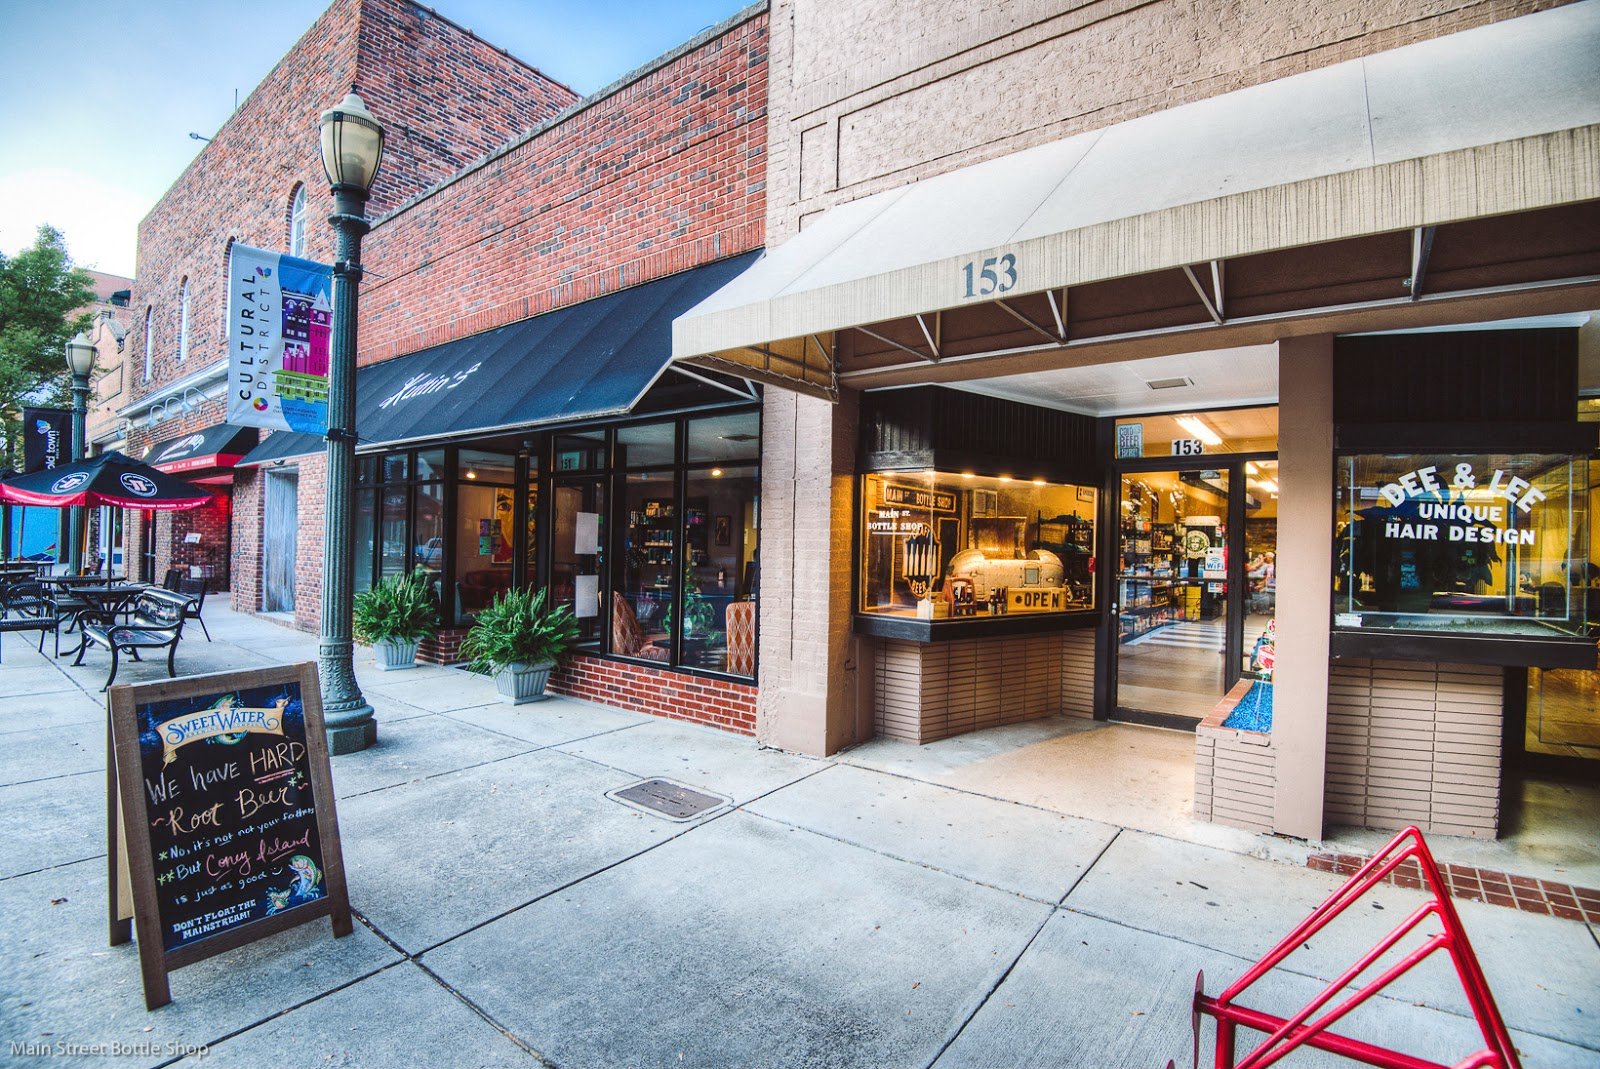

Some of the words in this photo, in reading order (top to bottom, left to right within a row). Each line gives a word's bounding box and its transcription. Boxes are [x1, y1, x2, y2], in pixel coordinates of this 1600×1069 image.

[962, 253, 1017, 298] 153
[239, 275, 256, 400] CULTURAL
[257, 288, 270, 390] DISTRICT
[46, 430, 56, 453] town
[1120, 435, 1139, 448] BEER
[1174, 440, 1202, 455] 153
[886, 488, 903, 502] MAIN
[916, 493, 936, 506] BOTTLE
[937, 496, 952, 508] SHOP
[1379, 465, 1441, 508] DEE
[1453, 462, 1476, 489] &
[1488, 469, 1547, 513] LEE
[879, 510, 899, 518] MAIN
[1419, 502, 1503, 523] UNIQUE
[867, 522, 897, 530] BOTTLE
[900, 522, 923, 530] SHOP
[1385, 523, 1438, 541] HAIR
[1449, 526, 1535, 546] DESIGN
[912, 579, 926, 594] BEER
[1024, 592, 1059, 608] OPEN
[250, 741, 306, 776] HARD
[166, 802, 224, 836] Root
[235, 785, 294, 819] Beer
[192, 836, 210, 850] it's
[214, 832, 234, 846] not
[238, 825, 254, 837] not
[256, 817, 279, 834] your
[176, 860, 202, 880] But
[206, 850, 250, 877] Coney
[256, 828, 310, 863] Island
[175, 894, 188, 905] is
[196, 886, 217, 902] just
[220, 882, 232, 892] as
[238, 871, 268, 890] good
[204, 906, 236, 923] FLOAT
[238, 898, 256, 912] THE
[182, 910, 250, 940] MAINSTREAM!
